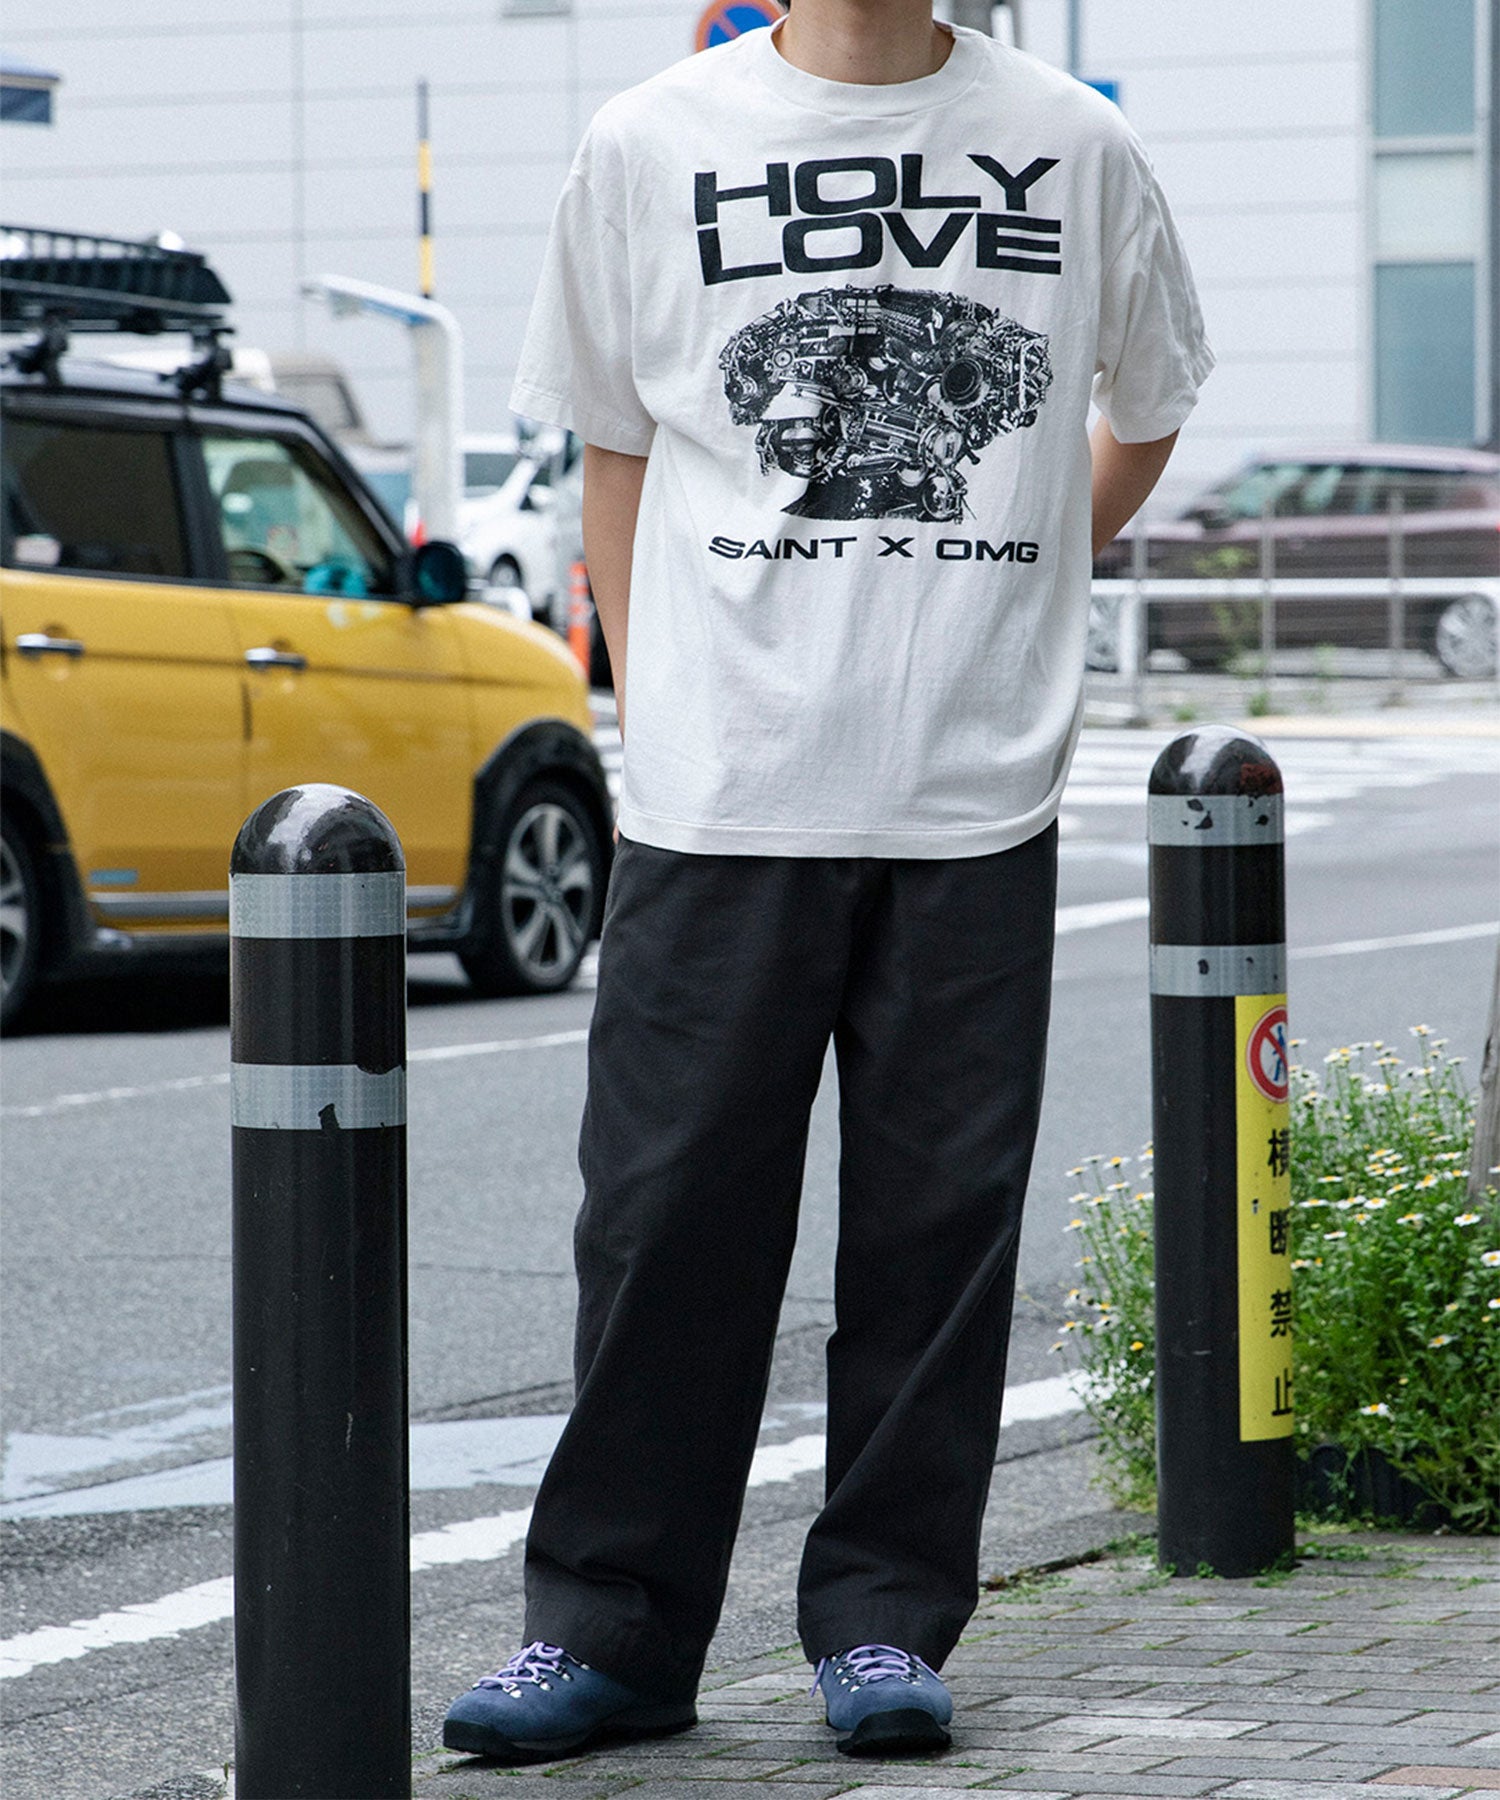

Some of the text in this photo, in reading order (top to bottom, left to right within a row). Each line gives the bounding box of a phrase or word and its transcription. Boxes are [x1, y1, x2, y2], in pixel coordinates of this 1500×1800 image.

[694, 153, 1061, 225] HOLY
[696, 211, 1062, 285] LOVE
[708, 536, 1040, 563] SAINT X OMG
